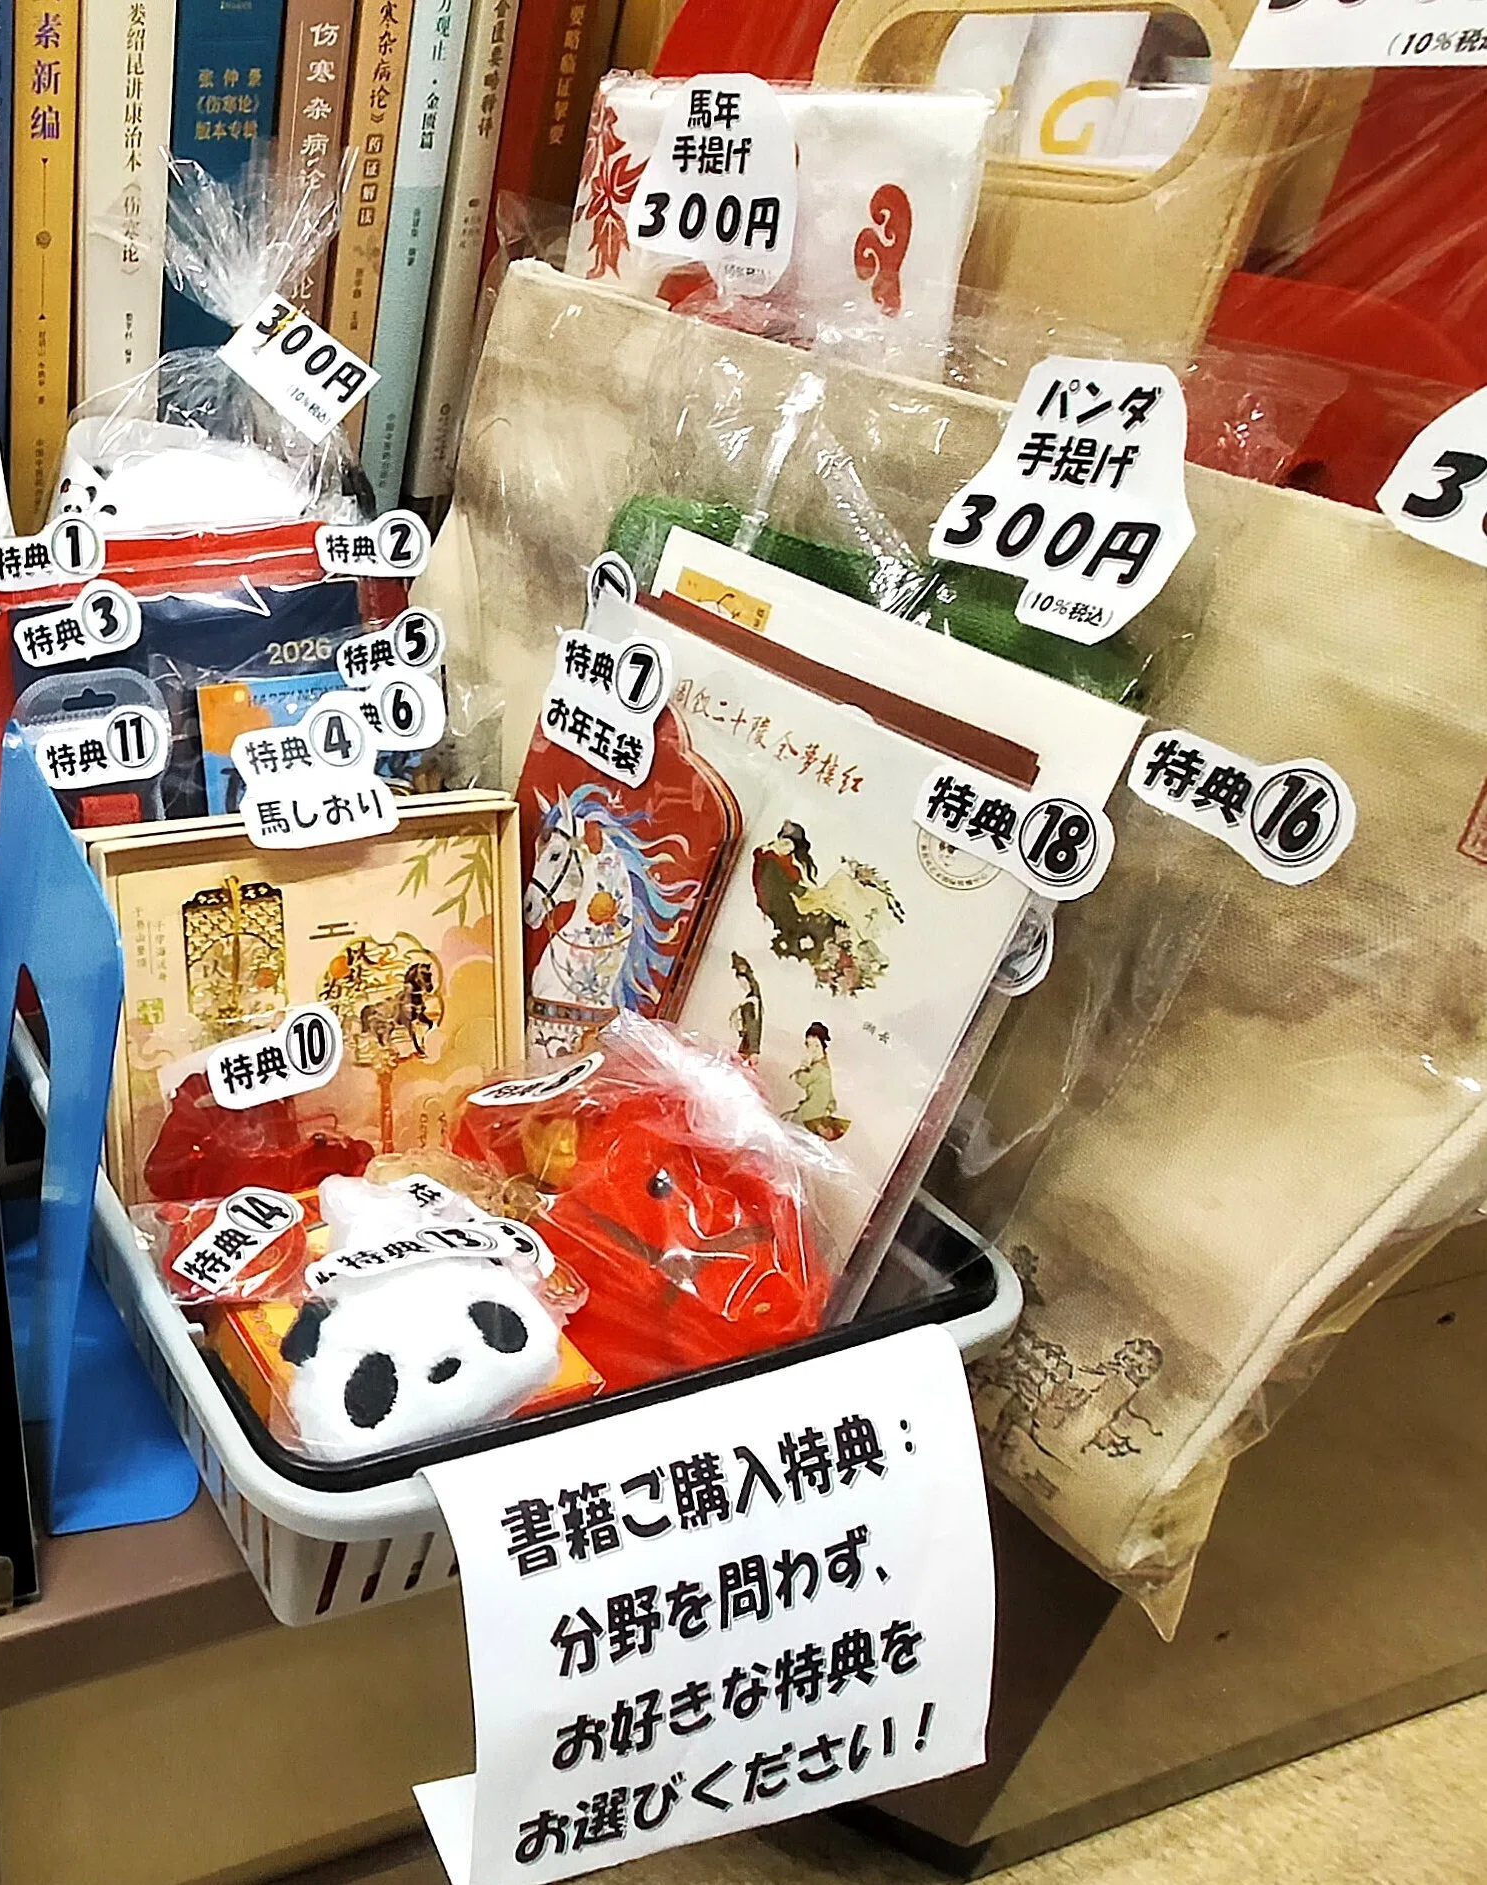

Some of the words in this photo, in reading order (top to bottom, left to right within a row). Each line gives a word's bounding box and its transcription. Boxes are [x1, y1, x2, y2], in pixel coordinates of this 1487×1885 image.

[687, 88, 742, 130] 馬年
[671, 135, 753, 175] 手提げ
[637, 191, 781, 251] 300円
[256, 302, 368, 405] 300円
[1036, 378, 1166, 432] パンダ
[1016, 431, 1143, 489] 手提げ
[1401, 449, 1487, 537] 3
[942, 493, 1165, 586] 300円
[1021, 588, 1115, 629] (10%税込)
[266, 637, 333, 666] 2026
[546, 697, 645, 776] お年玉袋
[257, 788, 385, 836] 馬しおり
[550, 1524, 891, 1679] 分野を問わず、
[551, 1619, 925, 1773] お好きな特典を
[513, 1701, 937, 1866] お選びください！
